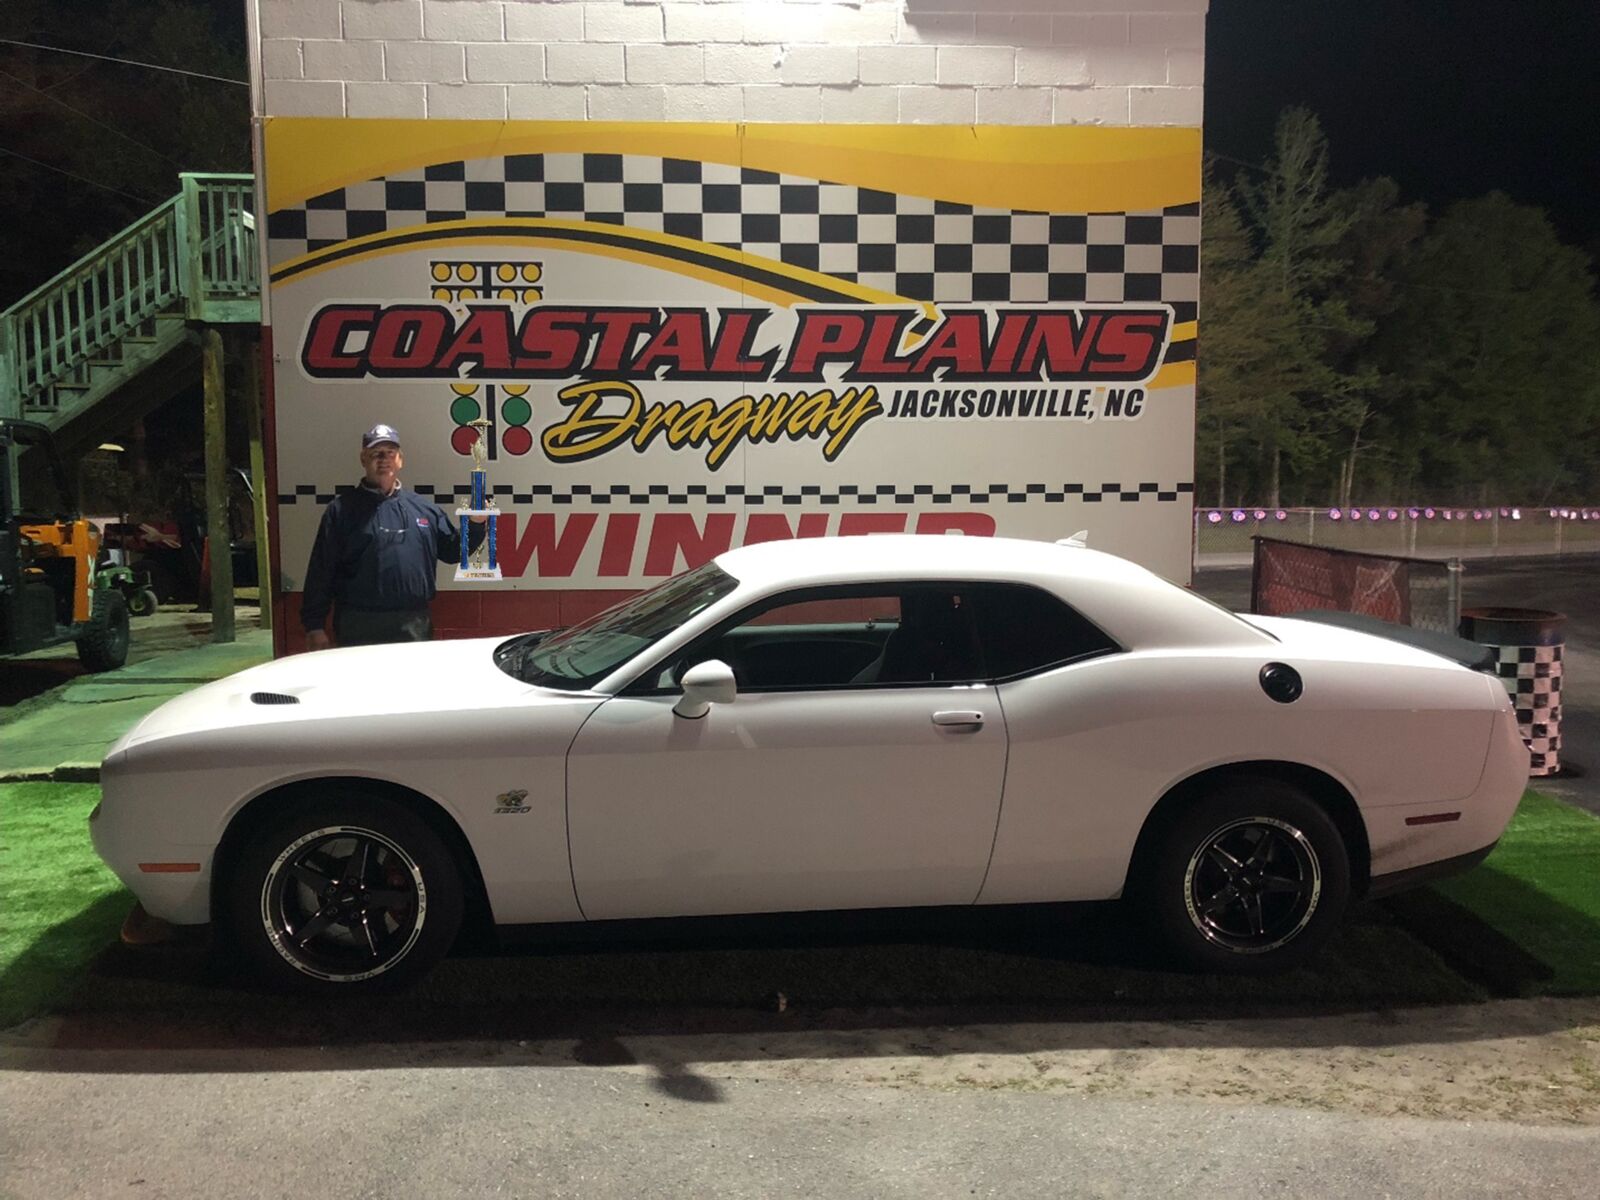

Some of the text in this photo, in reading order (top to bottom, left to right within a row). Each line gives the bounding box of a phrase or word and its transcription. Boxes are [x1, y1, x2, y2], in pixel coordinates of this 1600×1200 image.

[302, 304, 1170, 382] COASTAL PLAINS
[541, 380, 884, 472] Dragway
[887, 388, 1144, 420] JACKSONVILLE, NC
